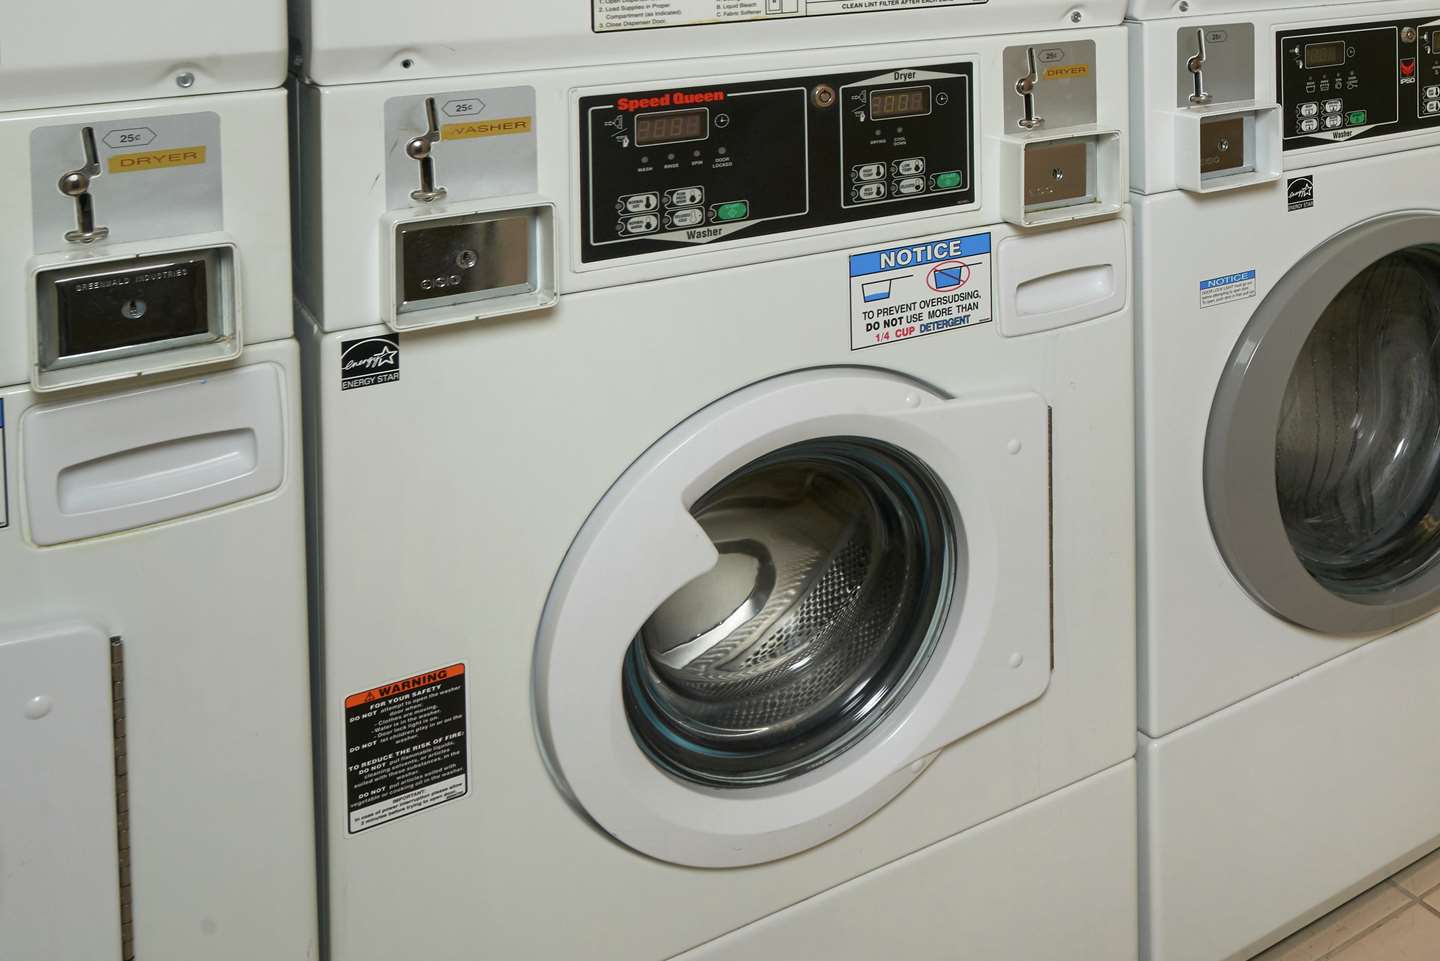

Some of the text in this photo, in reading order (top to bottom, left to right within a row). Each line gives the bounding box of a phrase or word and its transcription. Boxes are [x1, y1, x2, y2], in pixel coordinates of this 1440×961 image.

[842, 2, 864, 10] CLEAN
[879, 0, 900, 7] FILTER
[894, 72, 916, 81] Dryer
[1047, 67, 1086, 77] DRYER
[617, 90, 726, 111] Speed Queen
[120, 152, 197, 167] DRYER
[686, 227, 723, 240] Washer
[880, 240, 962, 268] NOTICE
[1208, 273, 1248, 287] NOTICE
[862, 290, 981, 320] TO PREVENT OVERSUDSING,
[866, 302, 979, 332] DO NOT USE MORE THAN
[875, 314, 971, 342] 1/4 CUP DETERGENT
[342, 372, 399, 390] ENERGY STAR
[379, 670, 448, 697] WARNING
[370, 684, 442, 710] FOR YOUR SAFETY
[361, 753, 393, 768] REDUCE
[395, 748, 410, 756] THE
[412, 742, 431, 751] RISK
[371, 762, 386, 771] NOT
[371, 786, 386, 795] NOT
